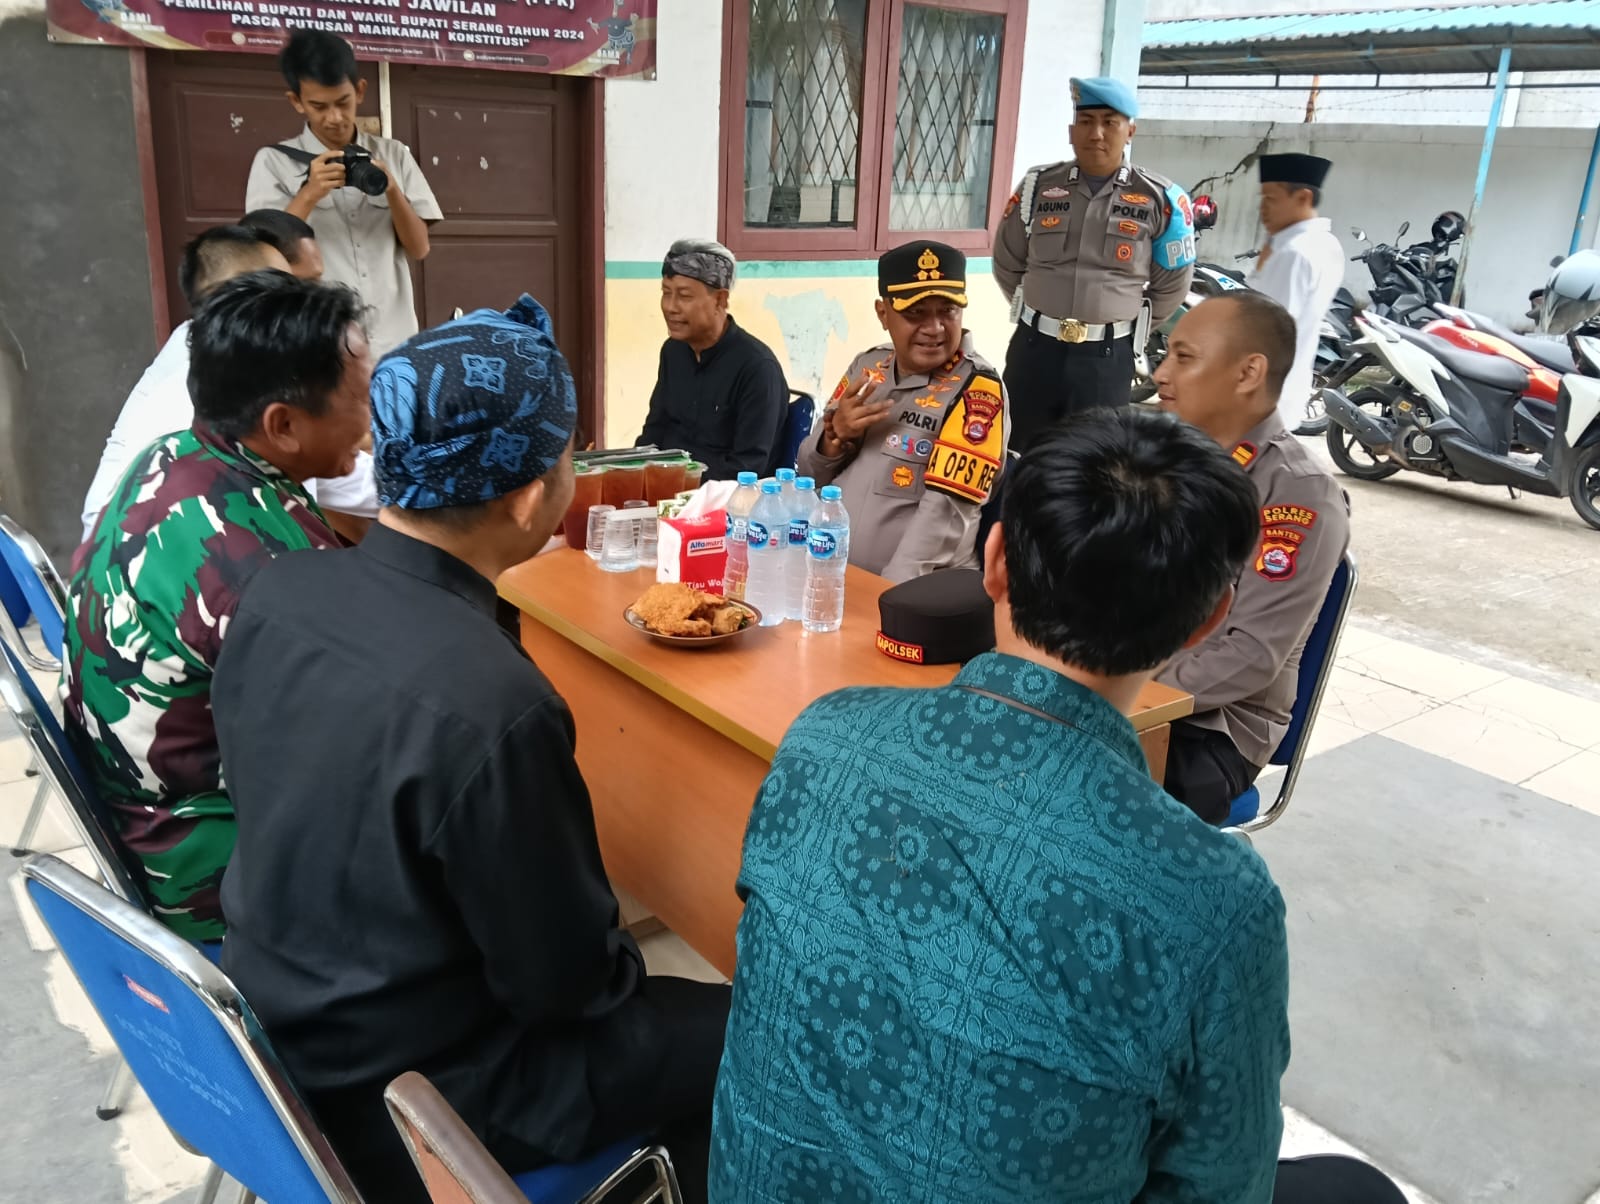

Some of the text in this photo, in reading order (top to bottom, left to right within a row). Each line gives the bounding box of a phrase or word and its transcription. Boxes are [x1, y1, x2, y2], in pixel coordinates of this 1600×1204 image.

[165, 0, 254, 13] PEMILIHAN
[258, 4, 311, 17] BUPATI
[316, 8, 347, 20] DAN
[351, 11, 396, 24] WAKIL
[400, 15, 448, 28] BUPATI
[452, 20, 503, 34] SERANG
[507, 25, 550, 38] TAHUN
[553, 29, 585, 41] 2024
[231, 14, 282, 28] PASCA
[285, 18, 354, 34] PUTUSAN
[358, 23, 440, 40] MAHKAMAH
[1037, 201, 1070, 213] AGUNG
[1112, 204, 1149, 221] POLRI
[900, 410, 938, 431] POLRI
[944, 452, 977, 484] OPS
[1263, 506, 1313, 519] POLRES
[1265, 513, 1309, 525] SERANG
[1266, 529, 1301, 541] BANTEN
[690, 540, 724, 550] Alfamart
